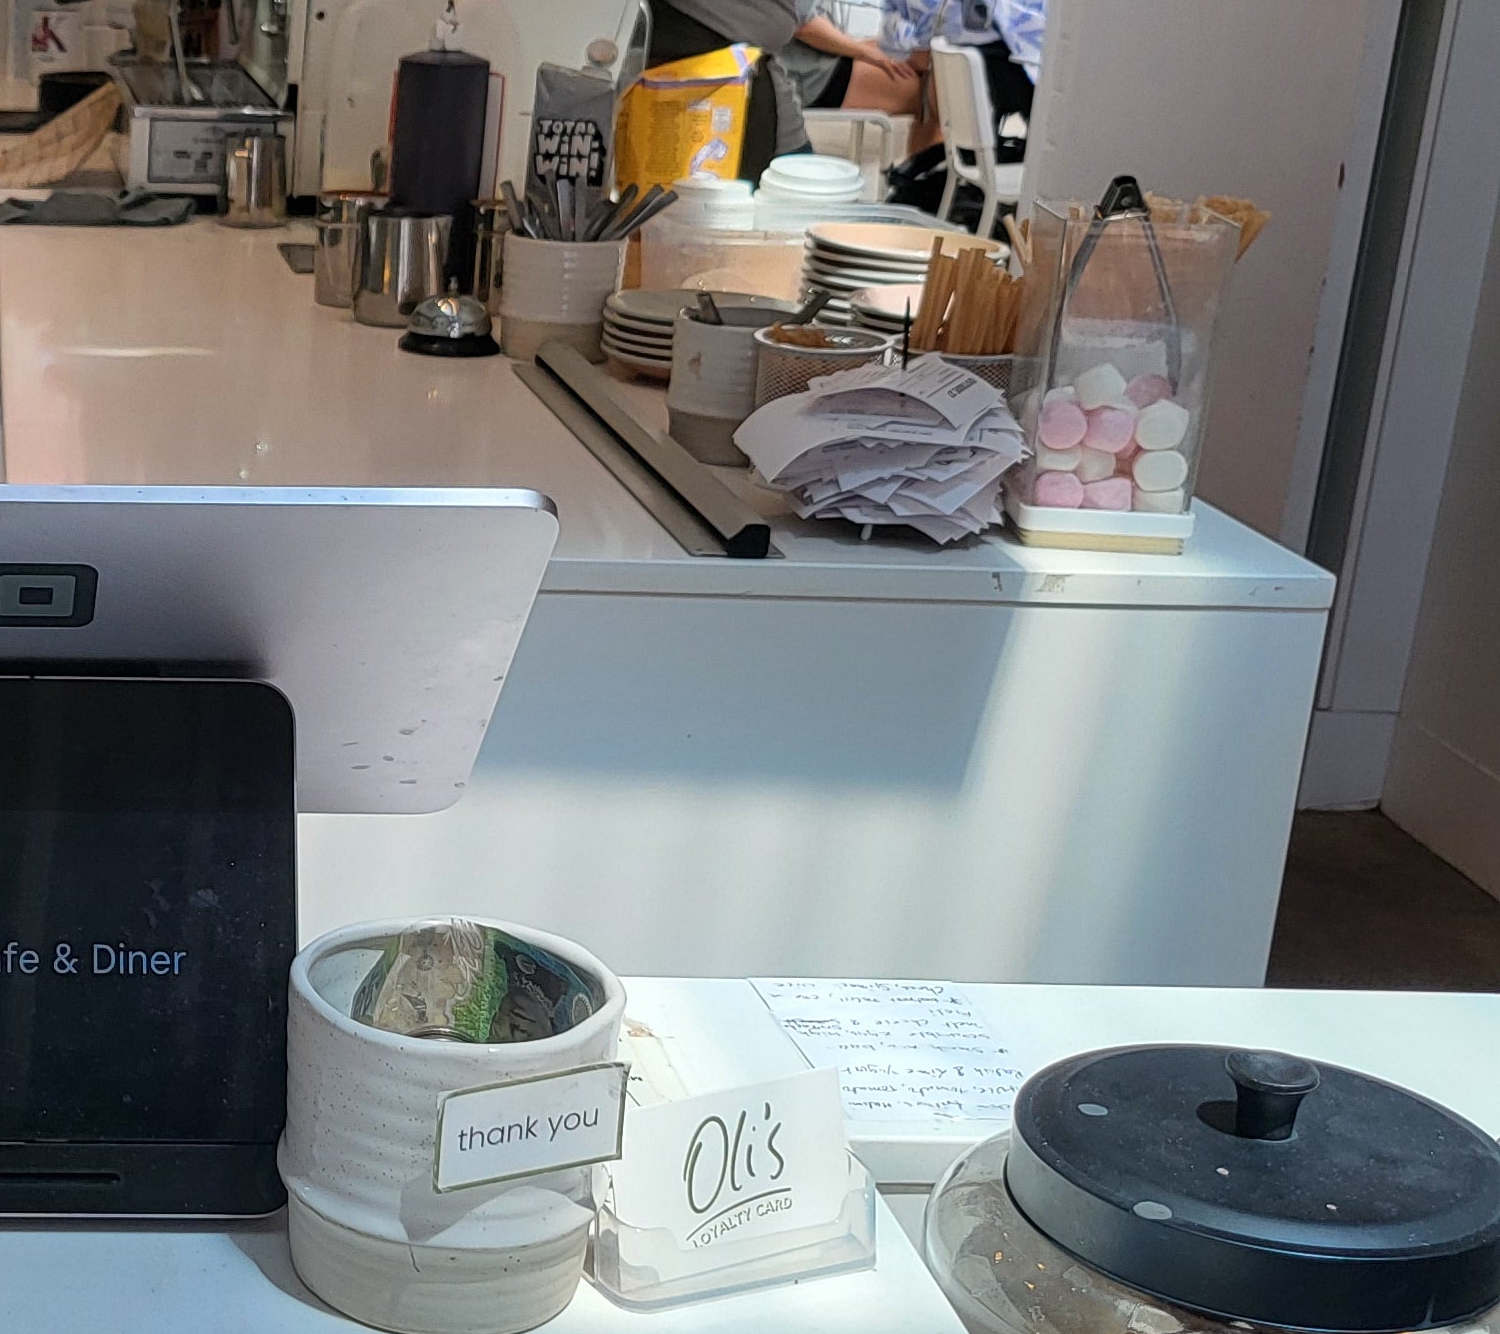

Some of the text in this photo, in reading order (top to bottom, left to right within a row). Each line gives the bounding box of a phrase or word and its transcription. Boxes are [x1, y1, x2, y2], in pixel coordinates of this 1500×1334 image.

[538, 119, 596, 136] TOTAL
[53, 943, 79, 974] &
[93, 942, 187, 975] Diner
[458, 1108, 599, 1152] thank you
[683, 1102, 785, 1214] Oli's
[693, 1197, 793, 1248] LOYALTY CARD
